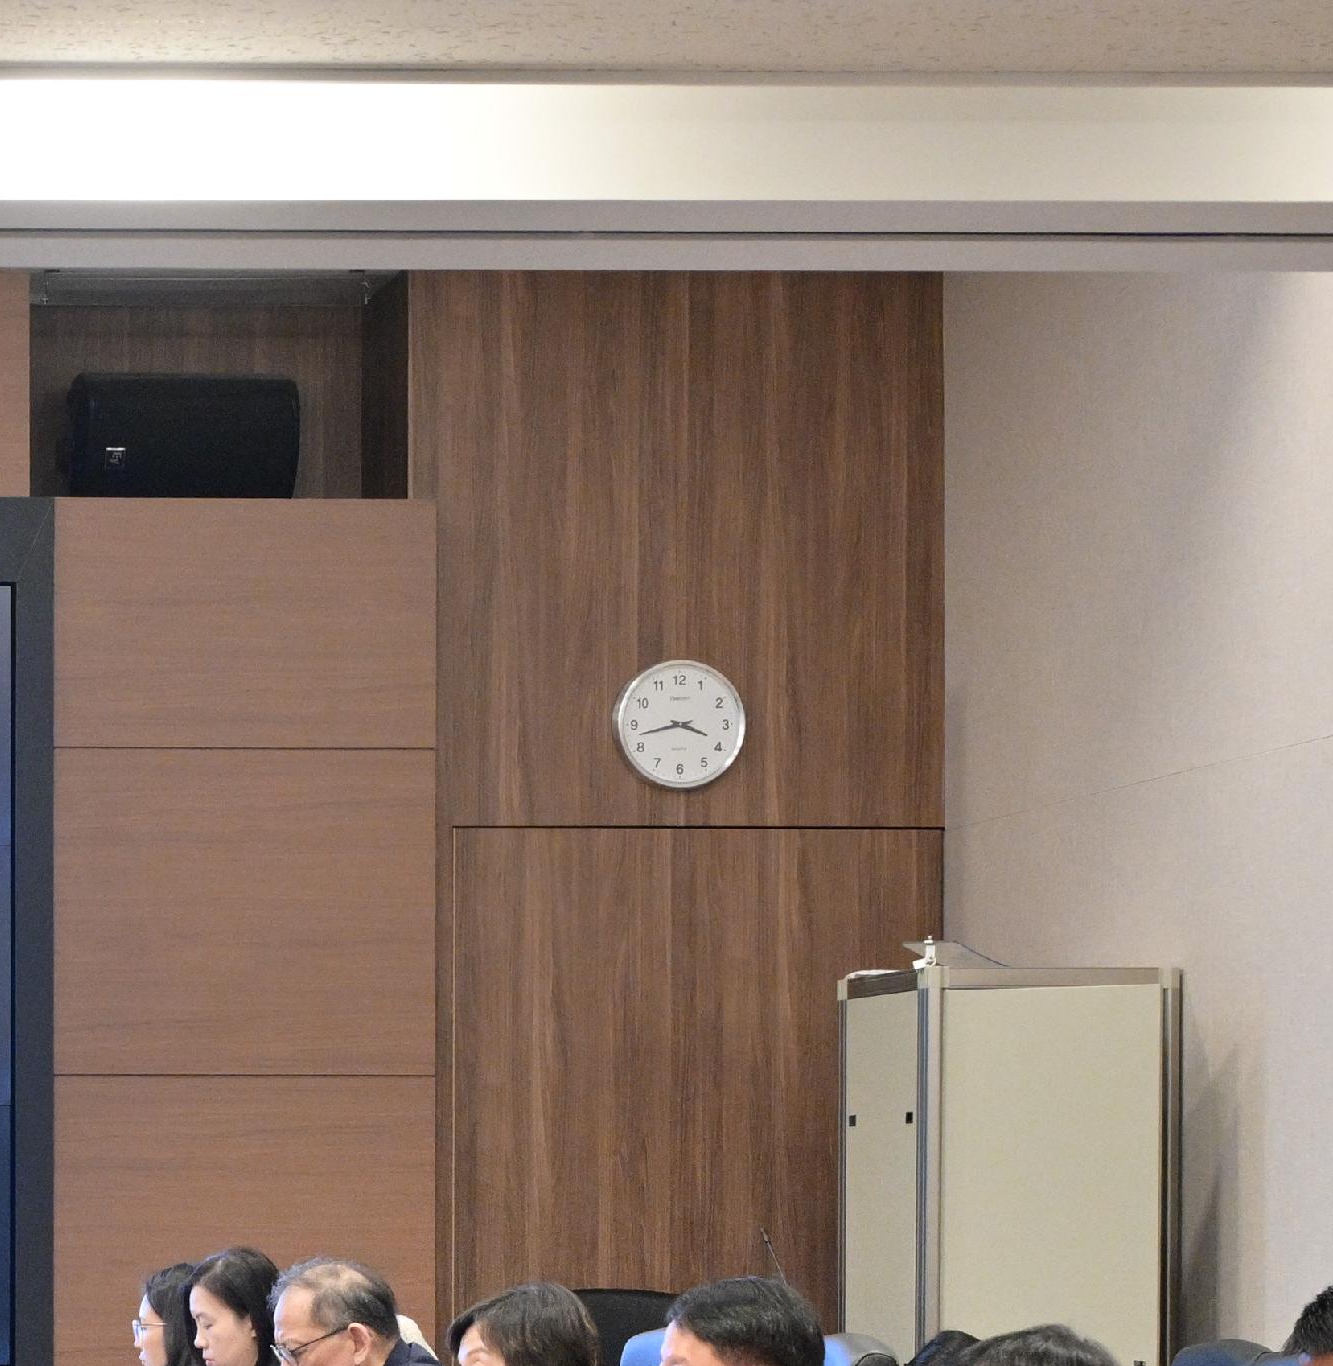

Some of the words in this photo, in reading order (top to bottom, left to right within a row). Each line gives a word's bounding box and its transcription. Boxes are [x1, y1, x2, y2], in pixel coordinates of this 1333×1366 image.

[673, 675, 686, 685] 12
[653, 681, 663, 691] 11
[698, 681, 703, 690] 1
[637, 698, 648, 709] 10
[715, 697, 724, 709] 2
[630, 720, 638, 730] 9
[722, 719, 729, 730] 3
[636, 742, 645, 752] 8
[714, 742, 722, 752] 4
[653, 758, 661, 768] 7
[701, 757, 708, 768] 5
[676, 764, 684, 774] 6
